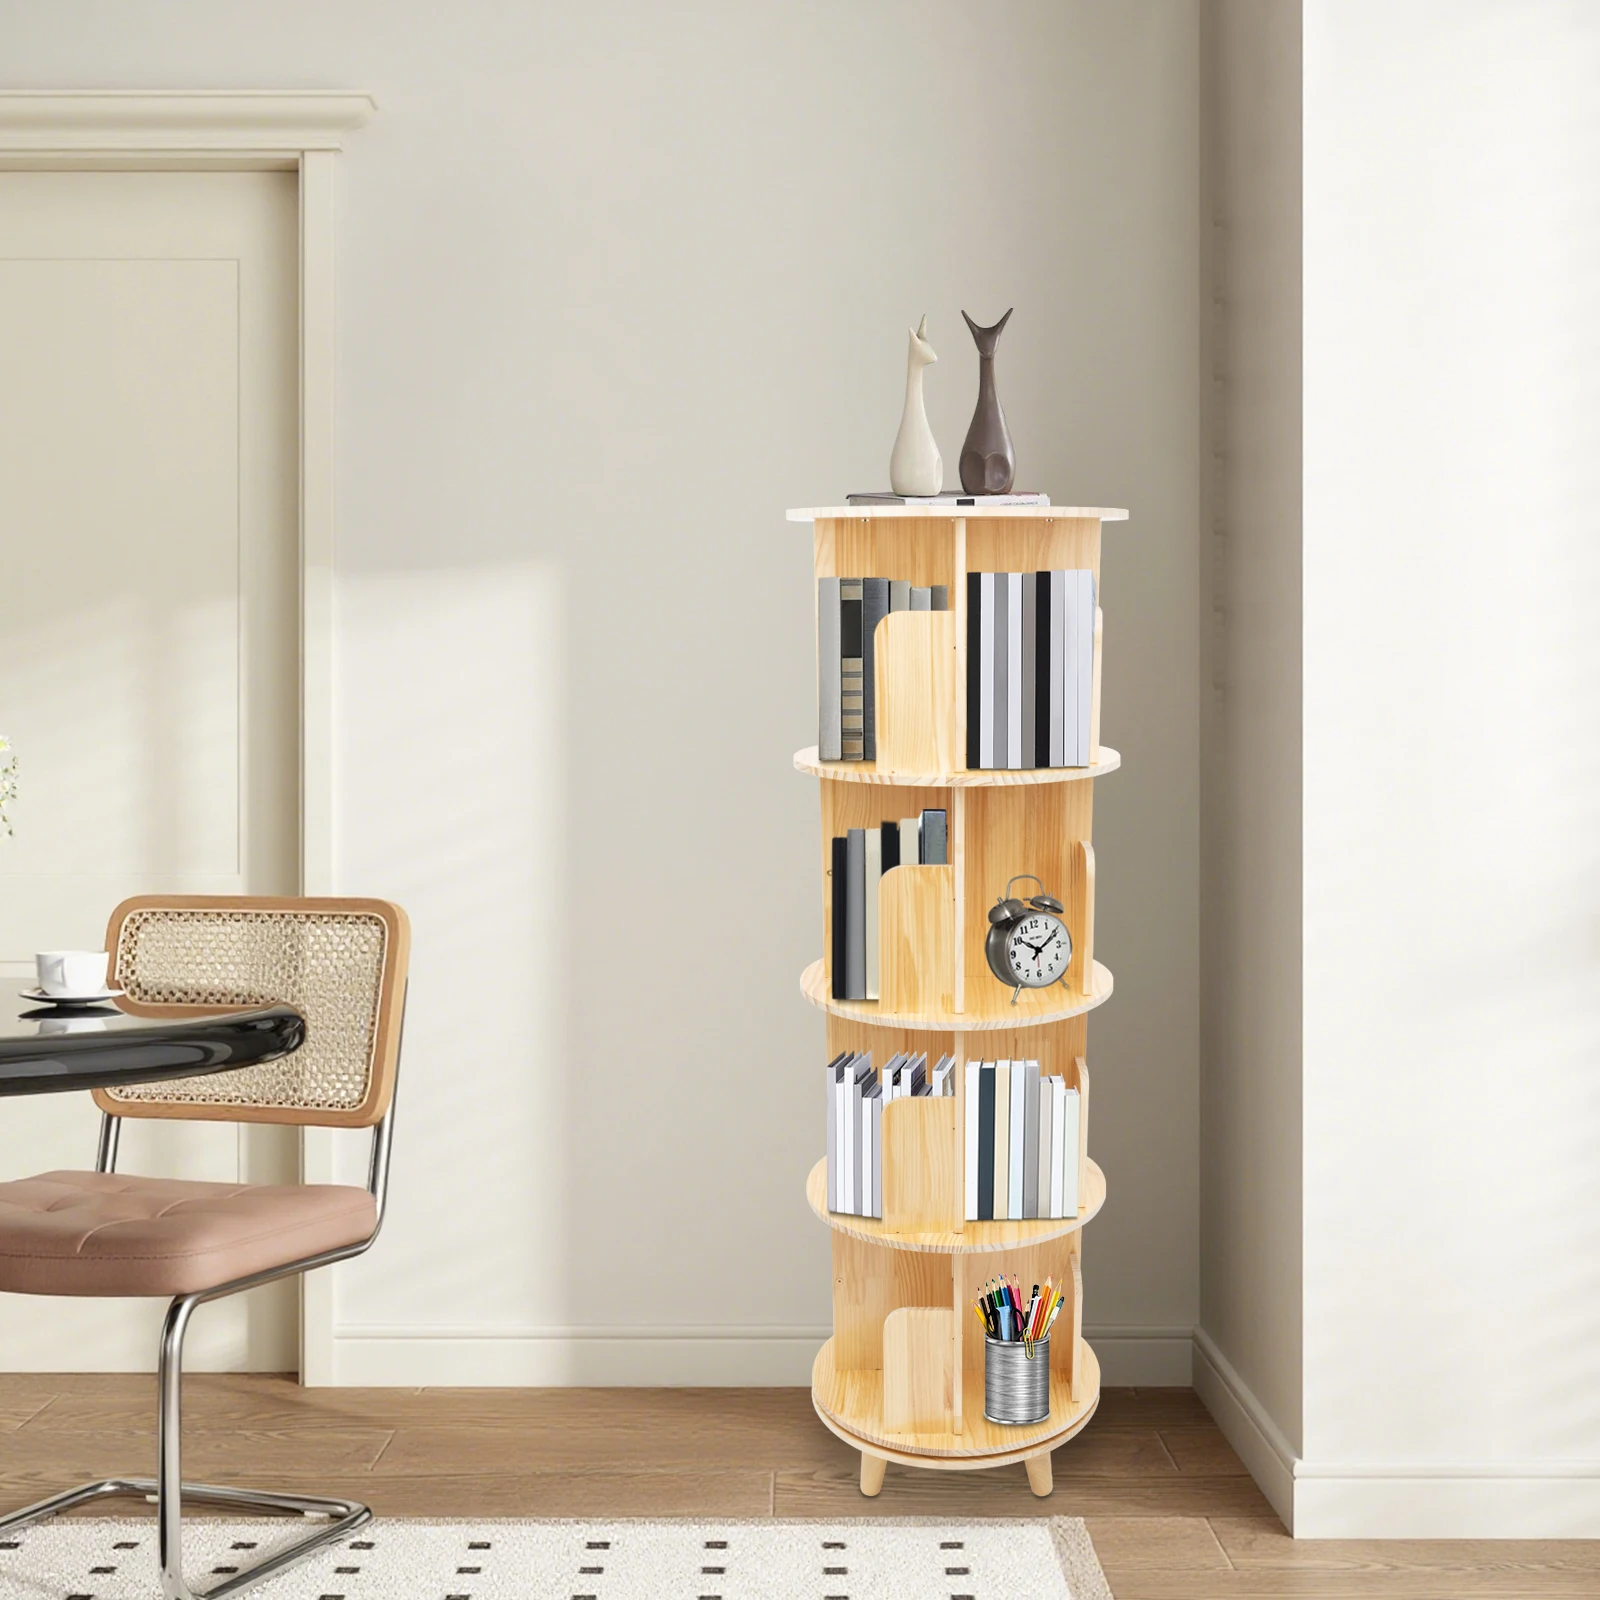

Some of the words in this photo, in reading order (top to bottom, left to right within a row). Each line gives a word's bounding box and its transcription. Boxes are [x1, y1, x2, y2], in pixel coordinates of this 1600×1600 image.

[1030, 920, 1038, 929] 12
[1044, 922, 1048, 930] 1
[1020, 926, 1028, 934] 11
[1014, 936, 1022, 946] 10
[1056, 940, 1061, 948] 3
[1010, 951, 1016, 959] 9
[1016, 962, 1021, 970] 8
[1025, 969, 1030, 977] 7
